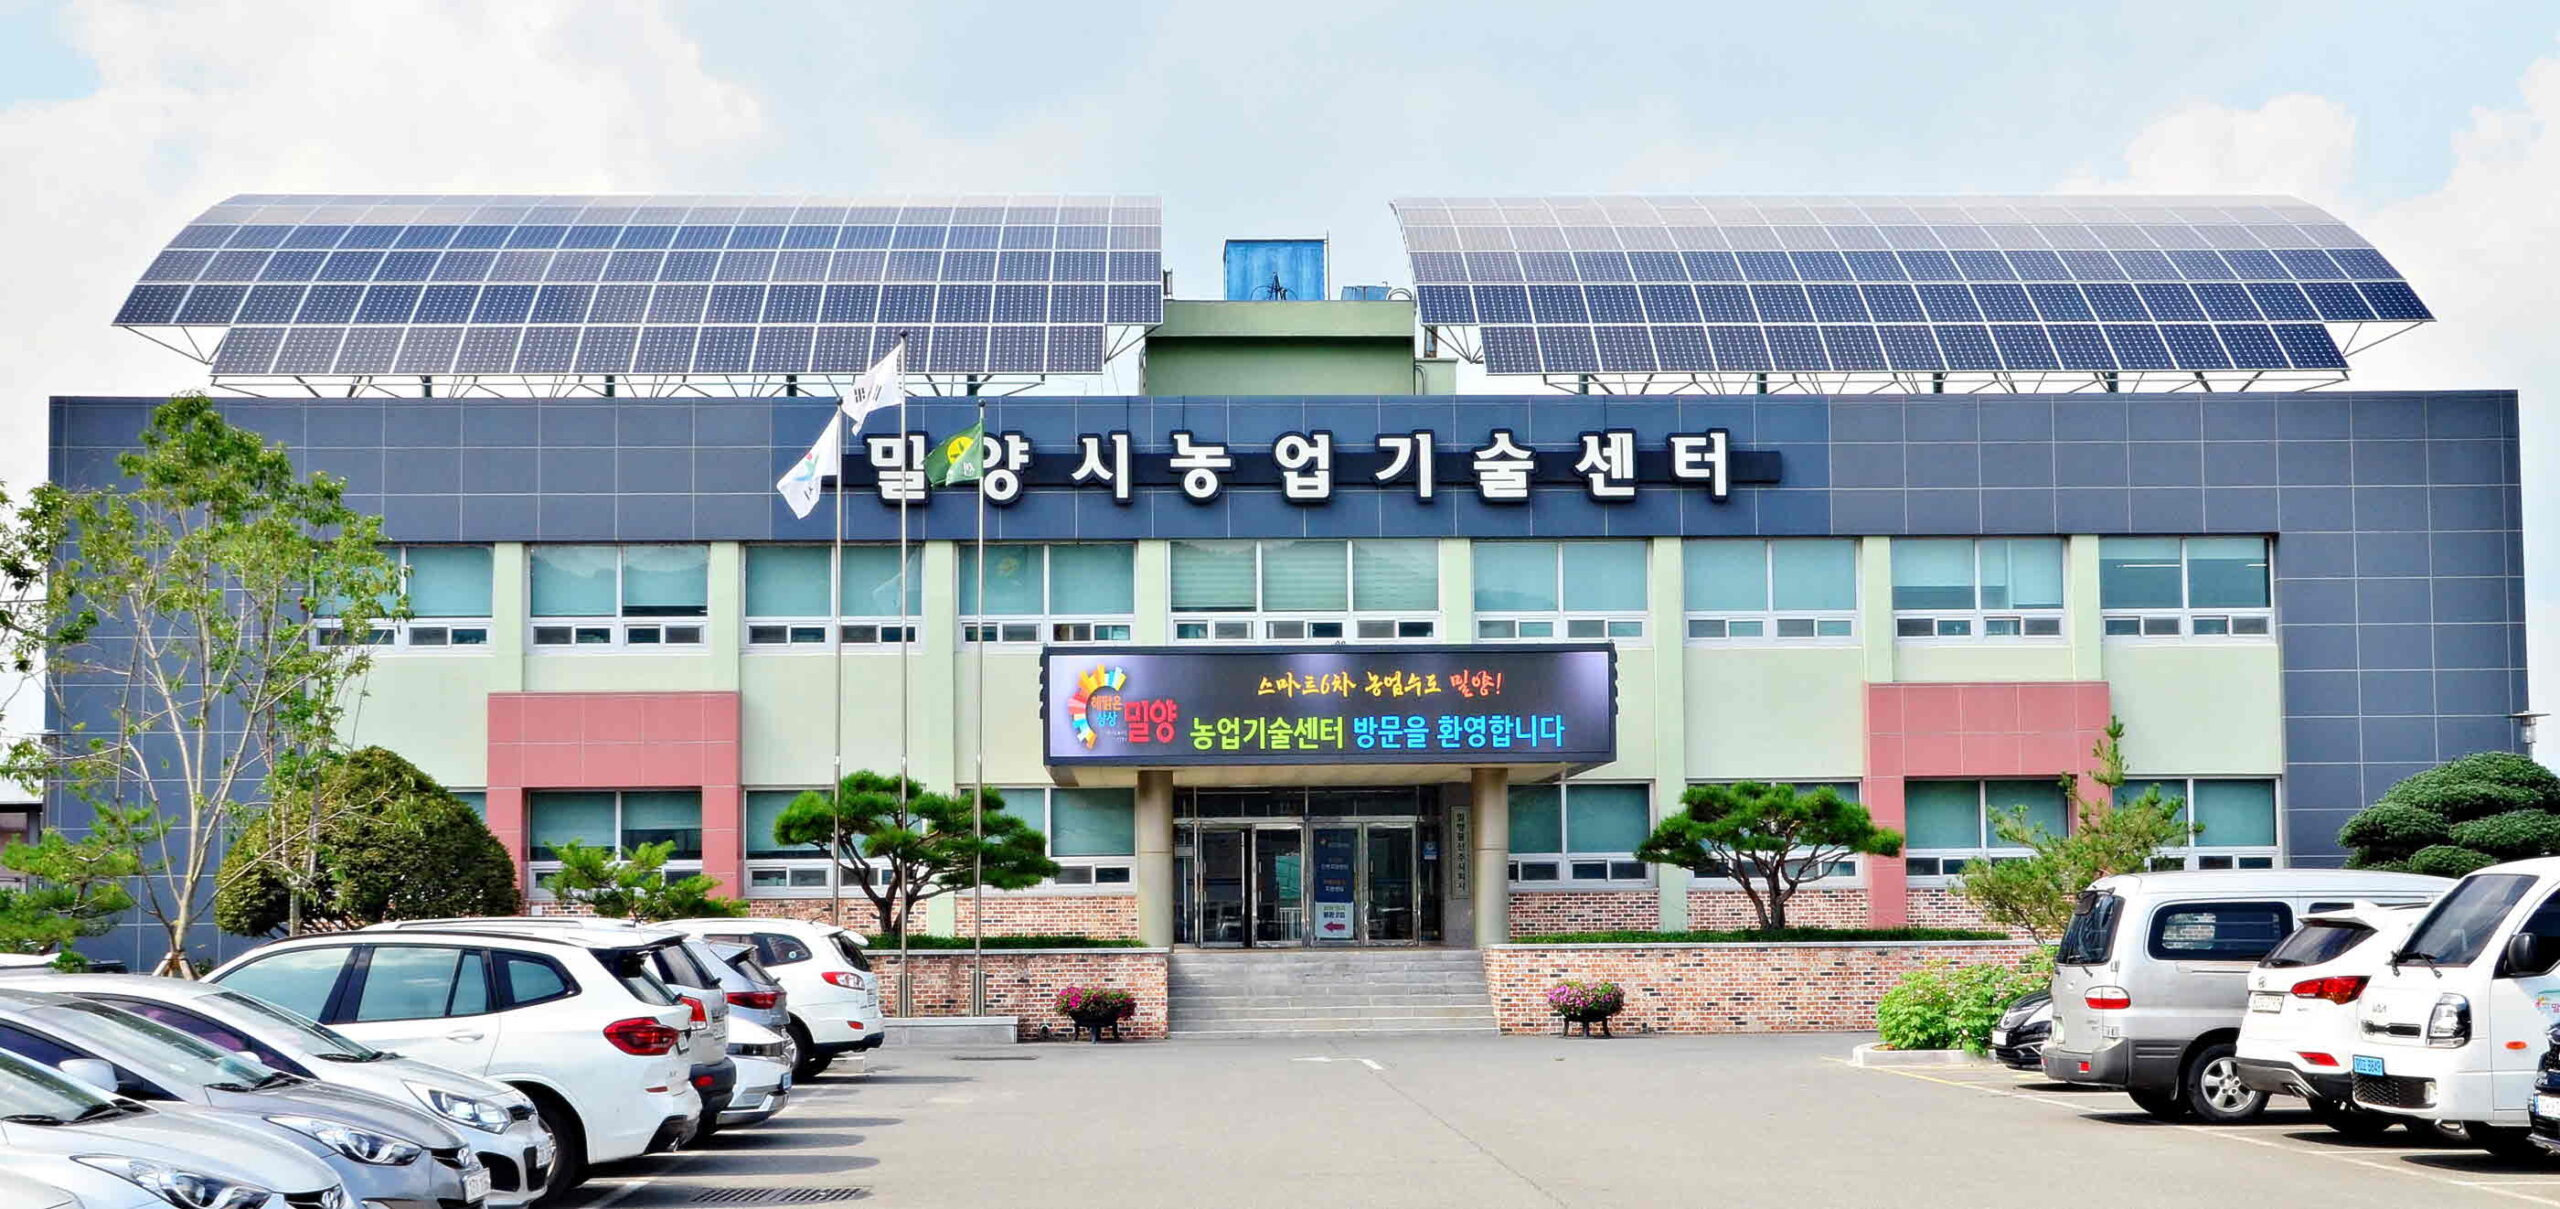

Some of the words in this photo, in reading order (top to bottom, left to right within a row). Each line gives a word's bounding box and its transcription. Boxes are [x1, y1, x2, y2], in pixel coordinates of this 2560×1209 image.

[1450, 669, 1502, 698] 밀양!
[1125, 698, 1178, 743] 밀양
[1190, 716, 1344, 750] 농업기술센터
[1353, 714, 1429, 749] 방문을
[1437, 714, 1565, 748] 환영합니다
